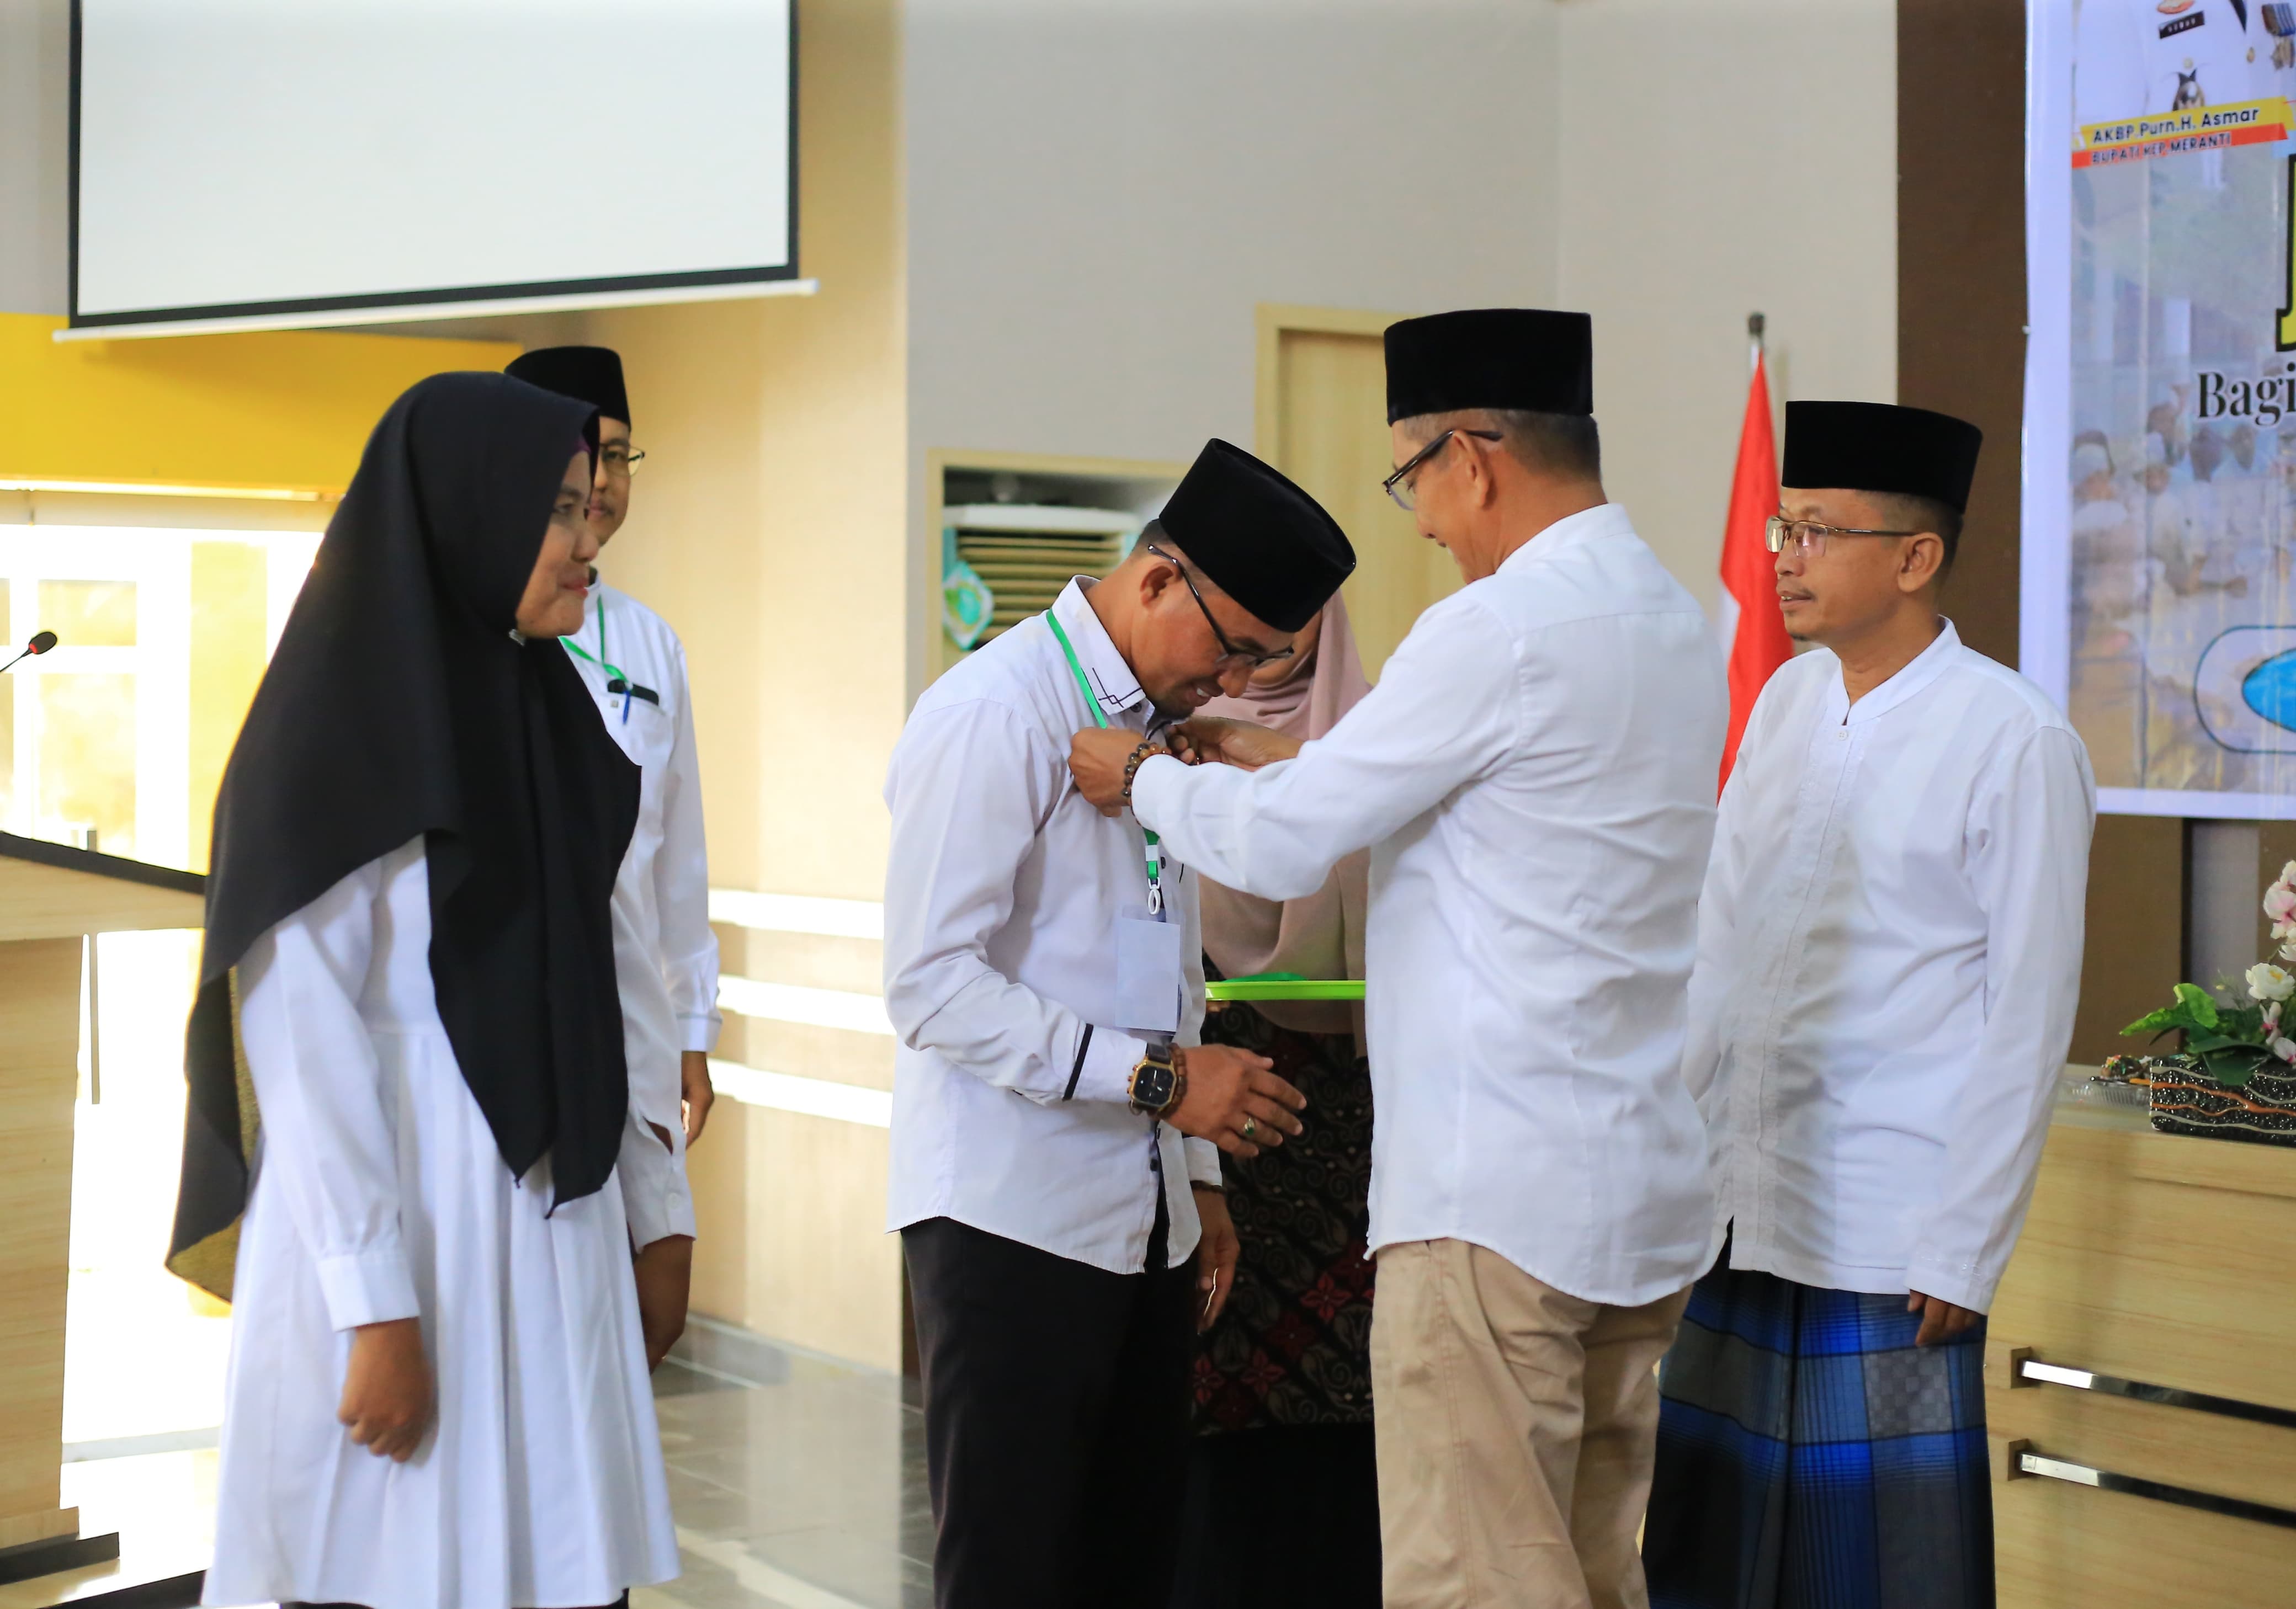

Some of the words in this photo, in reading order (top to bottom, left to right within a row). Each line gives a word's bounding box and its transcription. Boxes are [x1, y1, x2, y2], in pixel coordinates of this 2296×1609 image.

[2202, 109, 2260, 127] Asmar
[2092, 146, 2139, 163] BUPATI
[2198, 361, 2296, 426] Bagi
